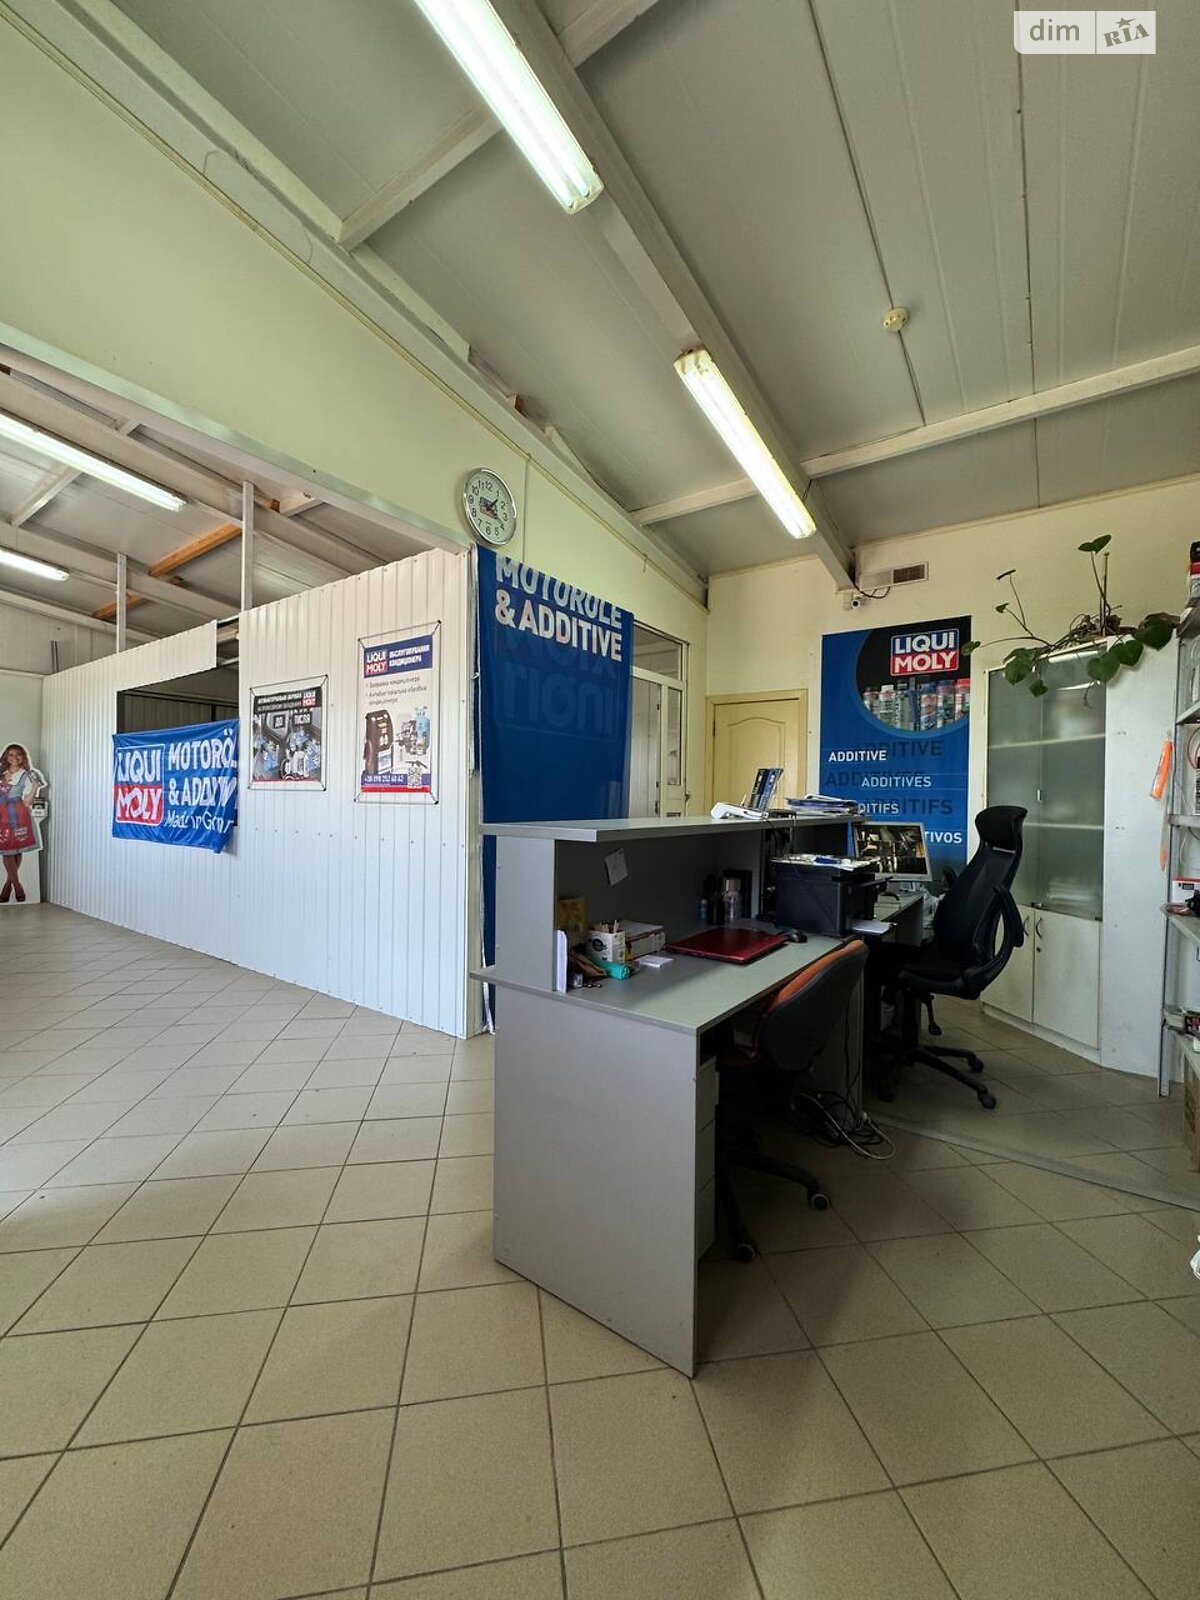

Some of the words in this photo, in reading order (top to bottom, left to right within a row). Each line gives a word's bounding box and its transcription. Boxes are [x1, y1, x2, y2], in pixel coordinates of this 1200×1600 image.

[495, 589, 516, 629] &
[518, 599, 622, 662] ADDITIVE
[895, 631, 955, 654] LIQUI
[893, 651, 956, 673] MOLY
[117, 749, 161, 783] LIQUI
[829, 750, 887, 762] ADDITIVE
[168, 778, 180, 806] &
[861, 776, 931, 787] ADDITIVES
[116, 787, 163, 820] MOLY
